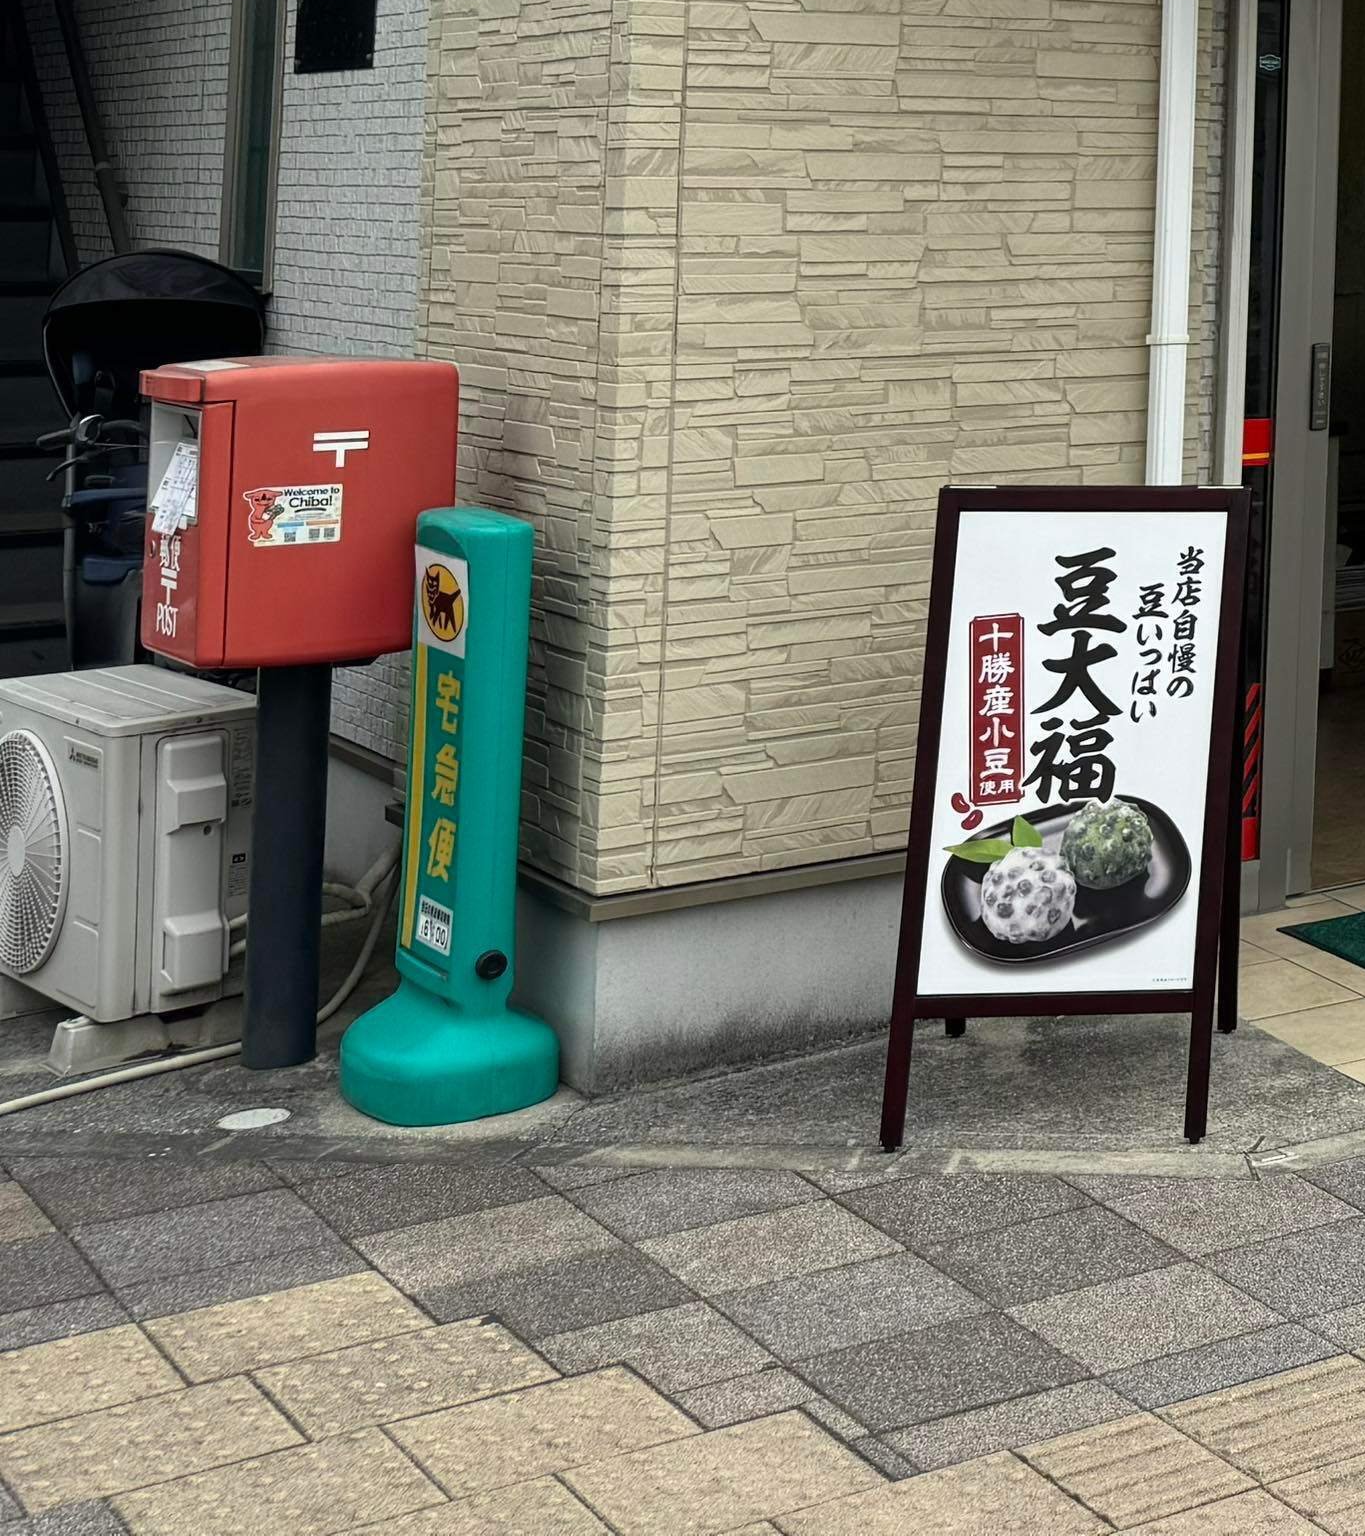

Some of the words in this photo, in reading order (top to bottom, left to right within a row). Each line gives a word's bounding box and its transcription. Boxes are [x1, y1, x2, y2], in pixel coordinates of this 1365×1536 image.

[284, 487, 328, 497] Welcome
[330, 486, 340, 494] to
[289, 495, 333, 508] Chiba!
[156, 602, 179, 638] POST
[1166, 545, 1205, 699] 当店自慢の
[978, 622, 1015, 778] 十勝産小豆
[1020, 546, 1128, 805] 豆大福
[427, 670, 460, 883] 宅急便
[978, 779, 1015, 797] 使用
